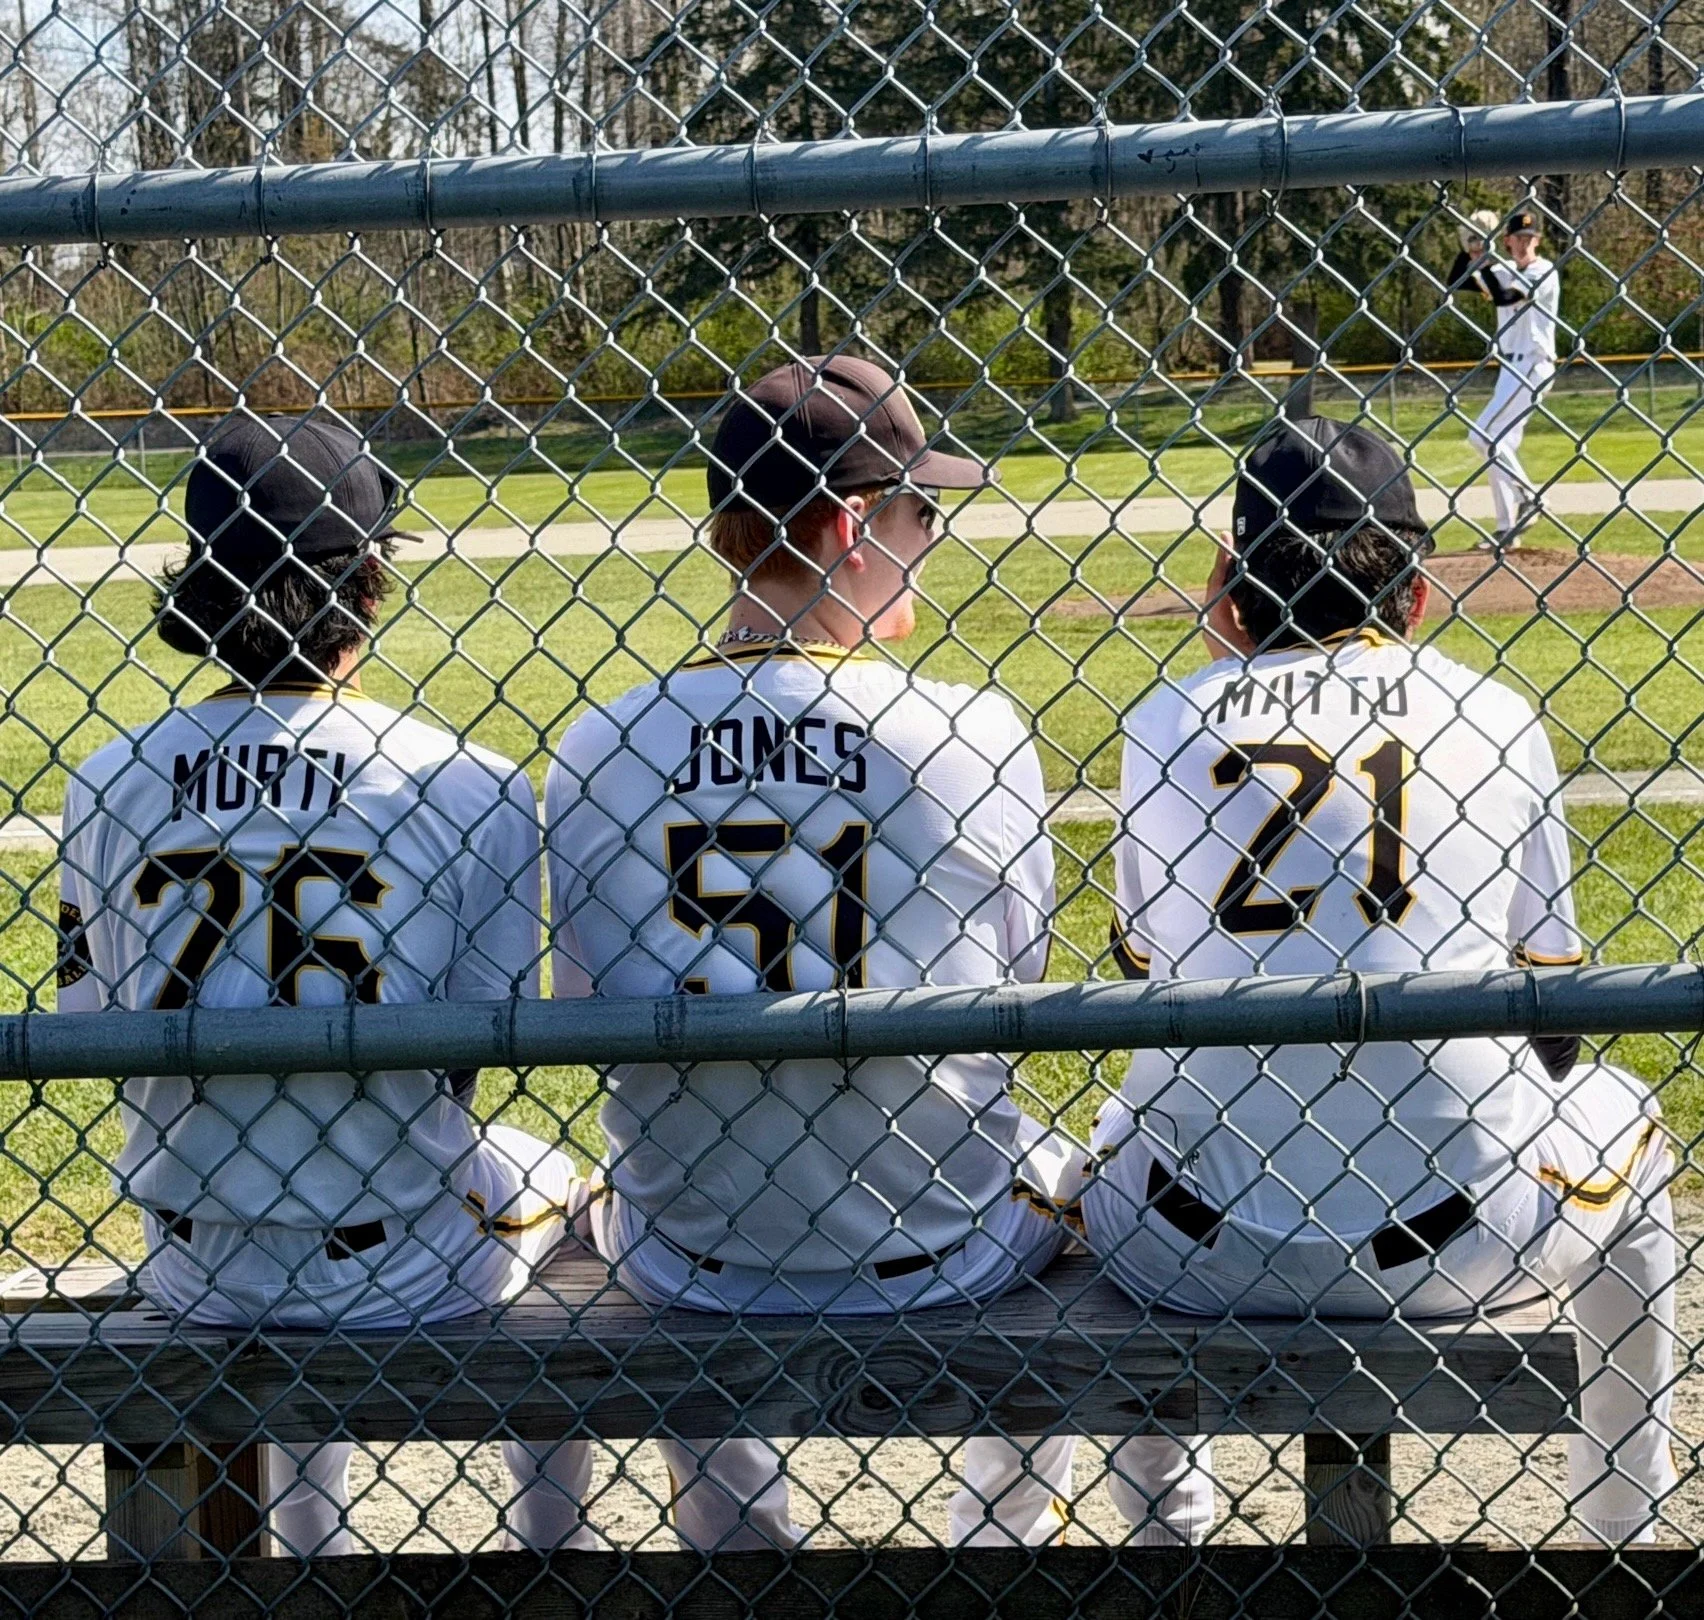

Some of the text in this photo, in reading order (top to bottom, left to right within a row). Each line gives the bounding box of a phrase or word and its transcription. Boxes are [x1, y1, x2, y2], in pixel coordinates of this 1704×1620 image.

[171, 744, 347, 821] MURTI
[672, 716, 867, 794] JONES
[1209, 738, 1418, 936] 21
[132, 844, 393, 1009] 26
[663, 820, 869, 995] 51
